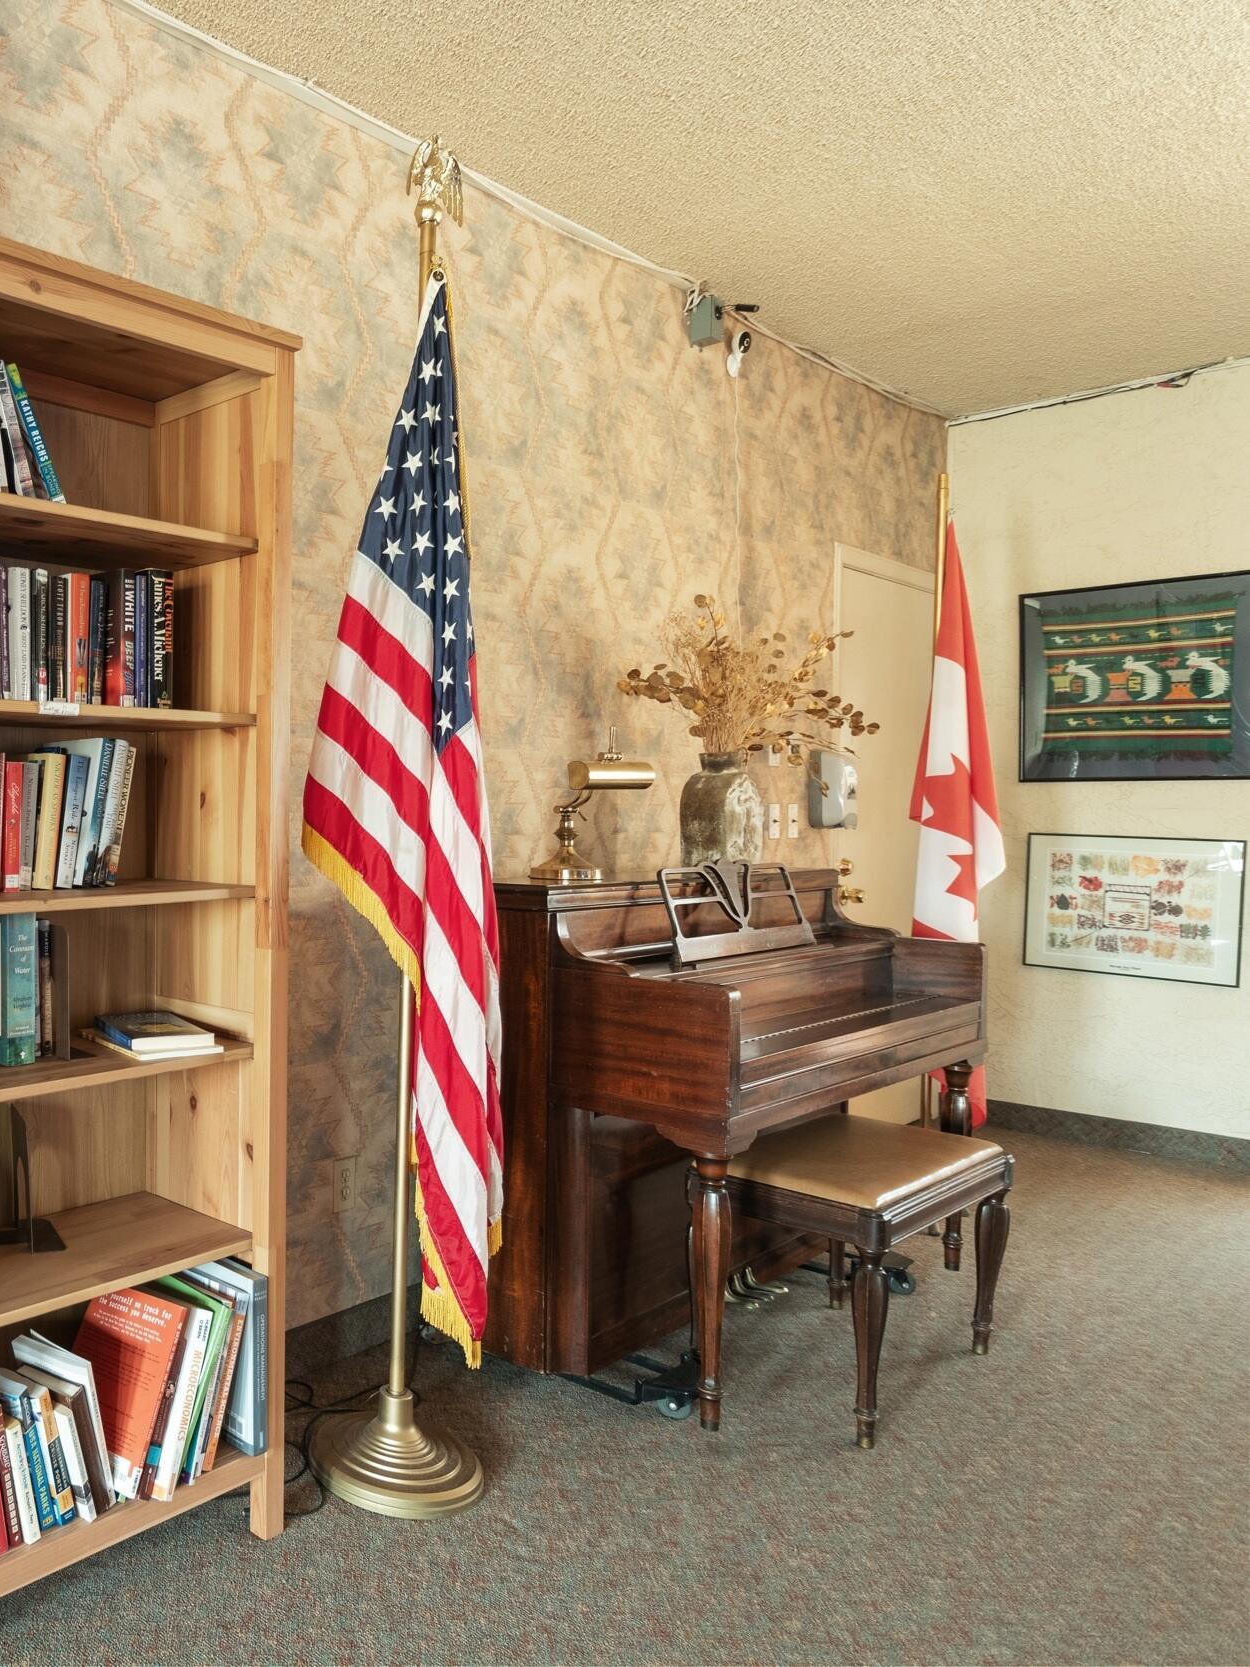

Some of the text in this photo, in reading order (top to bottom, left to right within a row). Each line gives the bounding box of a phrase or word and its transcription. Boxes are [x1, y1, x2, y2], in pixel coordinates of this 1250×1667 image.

[21, 400, 49, 461] KATHY REICHS
[124, 590, 134, 632] WHITE
[9, 945, 34, 953] Covenant
[178, 1350, 203, 1442] MICROECONOMICS
